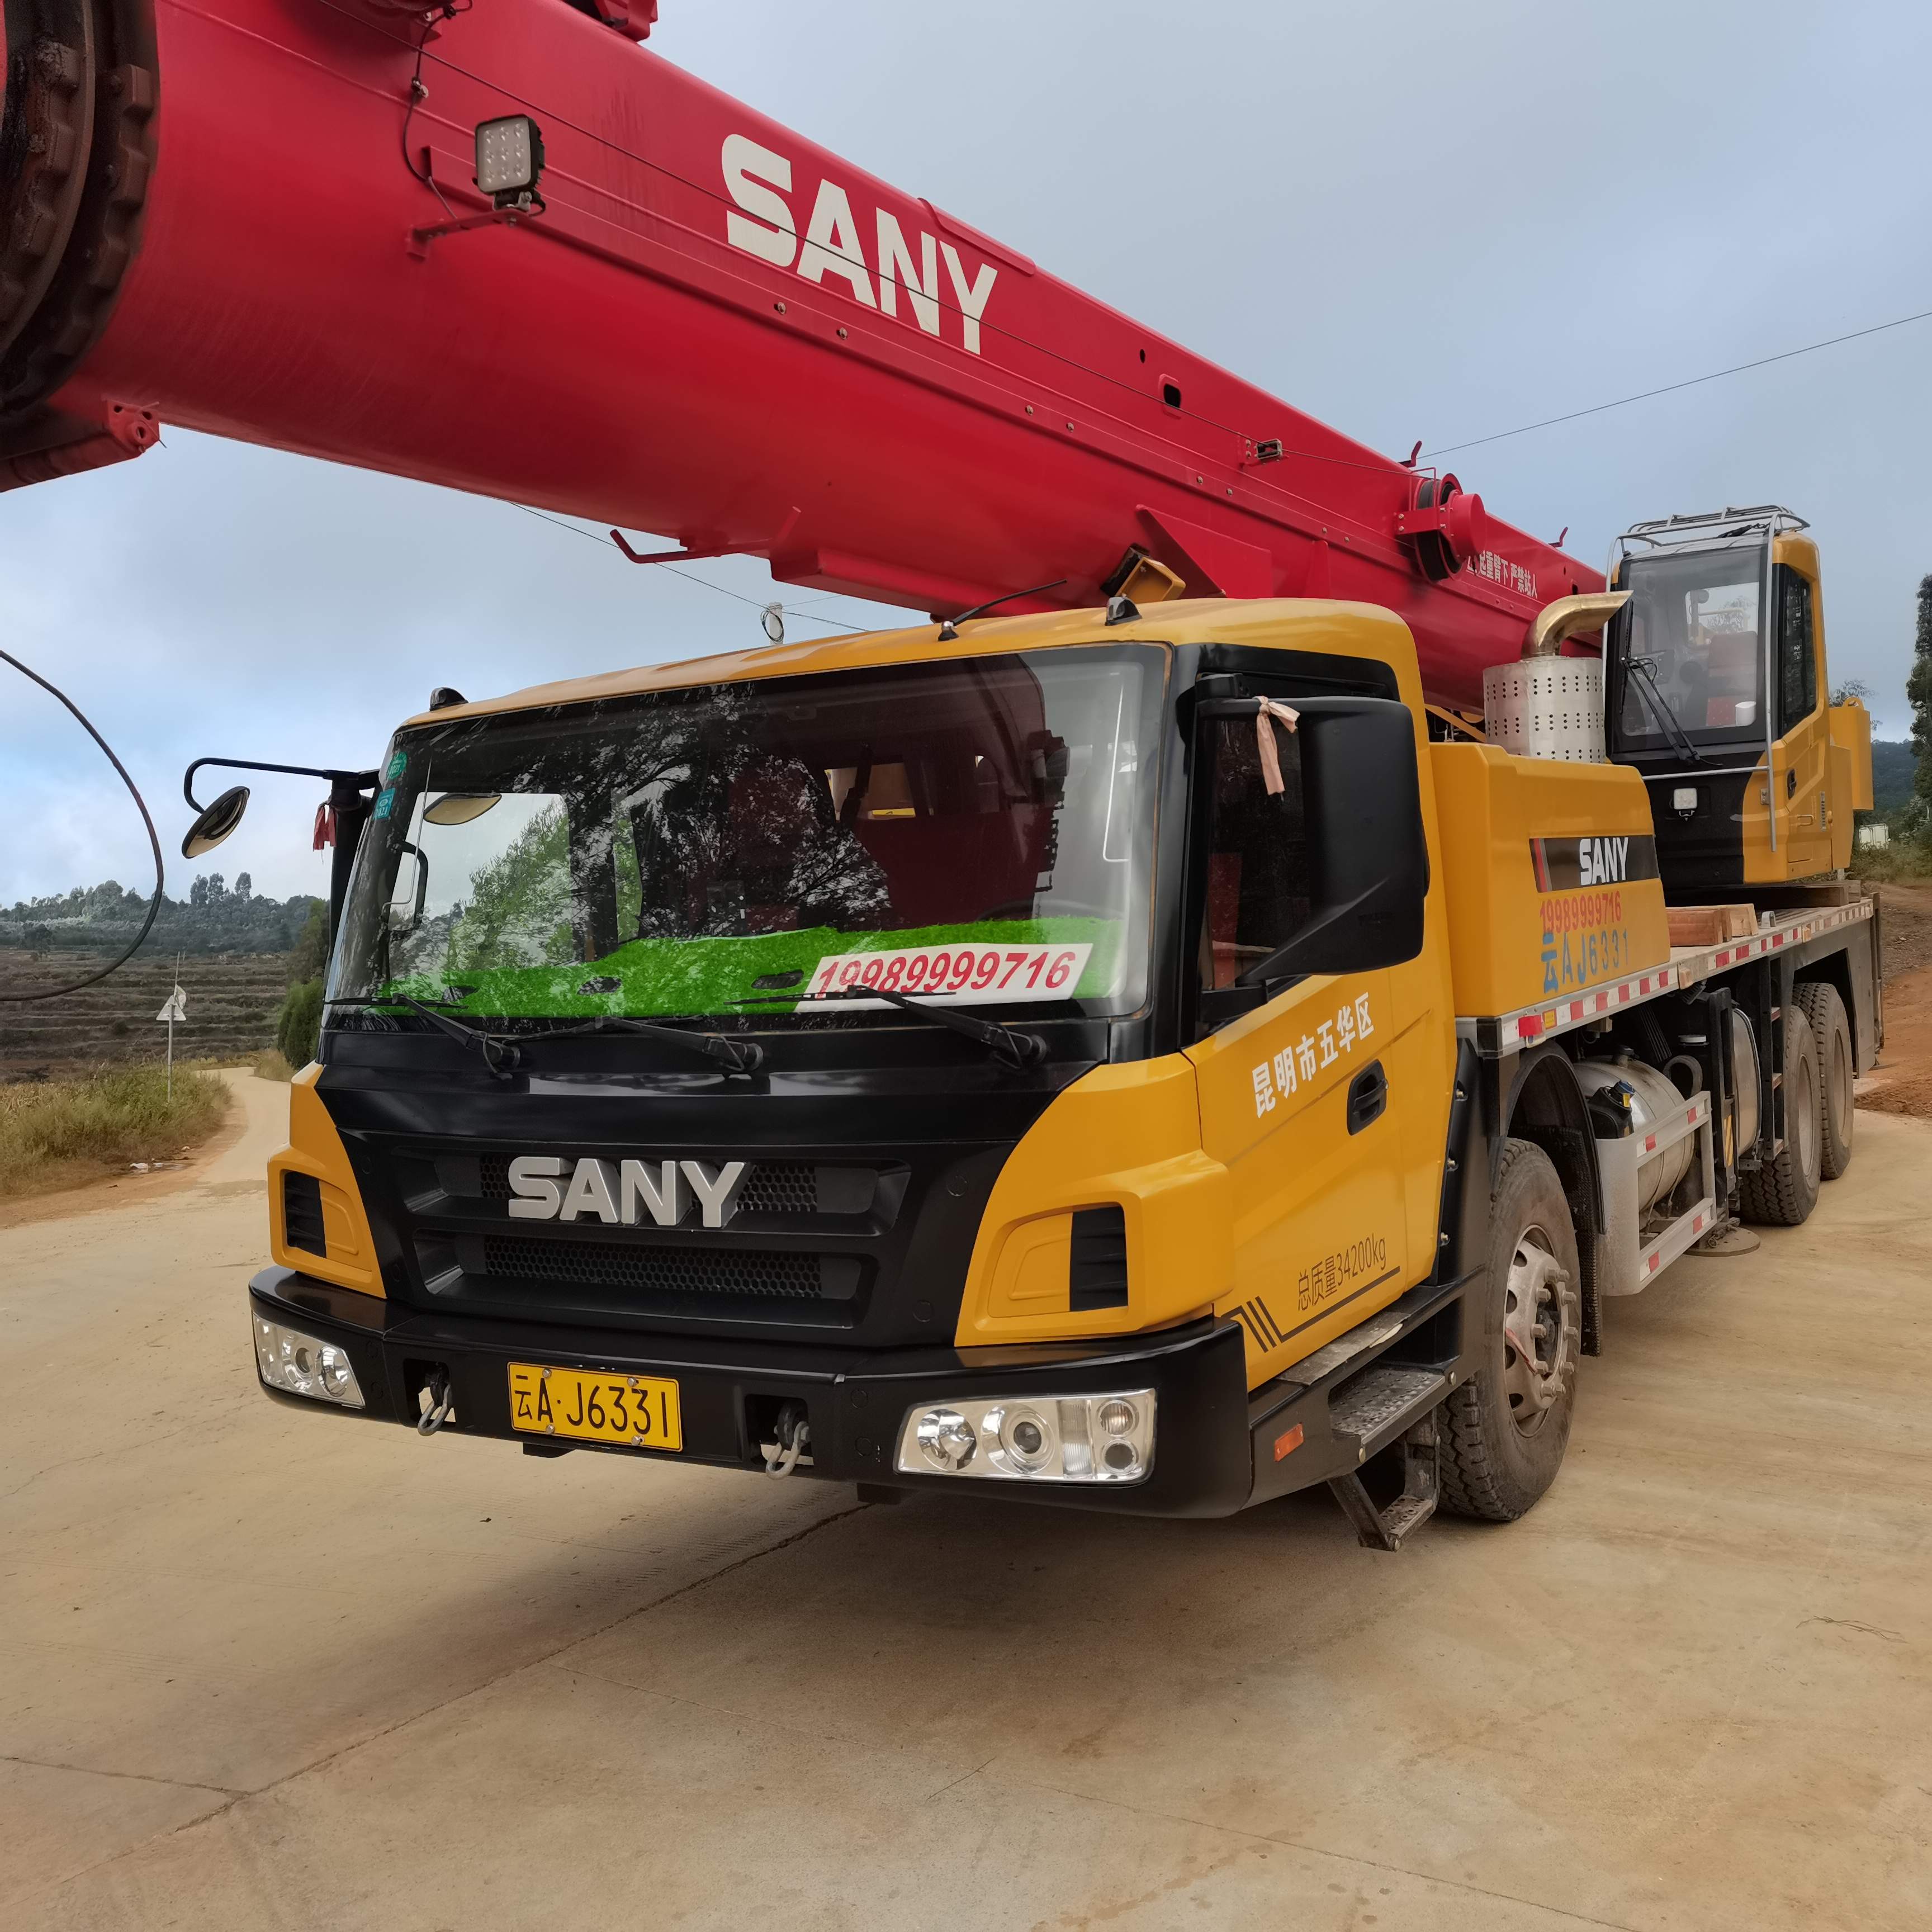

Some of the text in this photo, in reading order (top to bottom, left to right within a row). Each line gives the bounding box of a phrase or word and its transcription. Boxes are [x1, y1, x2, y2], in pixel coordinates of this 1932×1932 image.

[722, 134, 998, 355] SANY
[1579, 837, 1629, 886] SANY
[1540, 891, 1622, 934] 19989999716
[816, 951, 1076, 1000] 19989999716
[1252, 992, 1374, 1119] 昆明市五华区
[508, 1156, 746, 1228] SANY
[1298, 1232, 1386, 1311] 总质量34200kg
